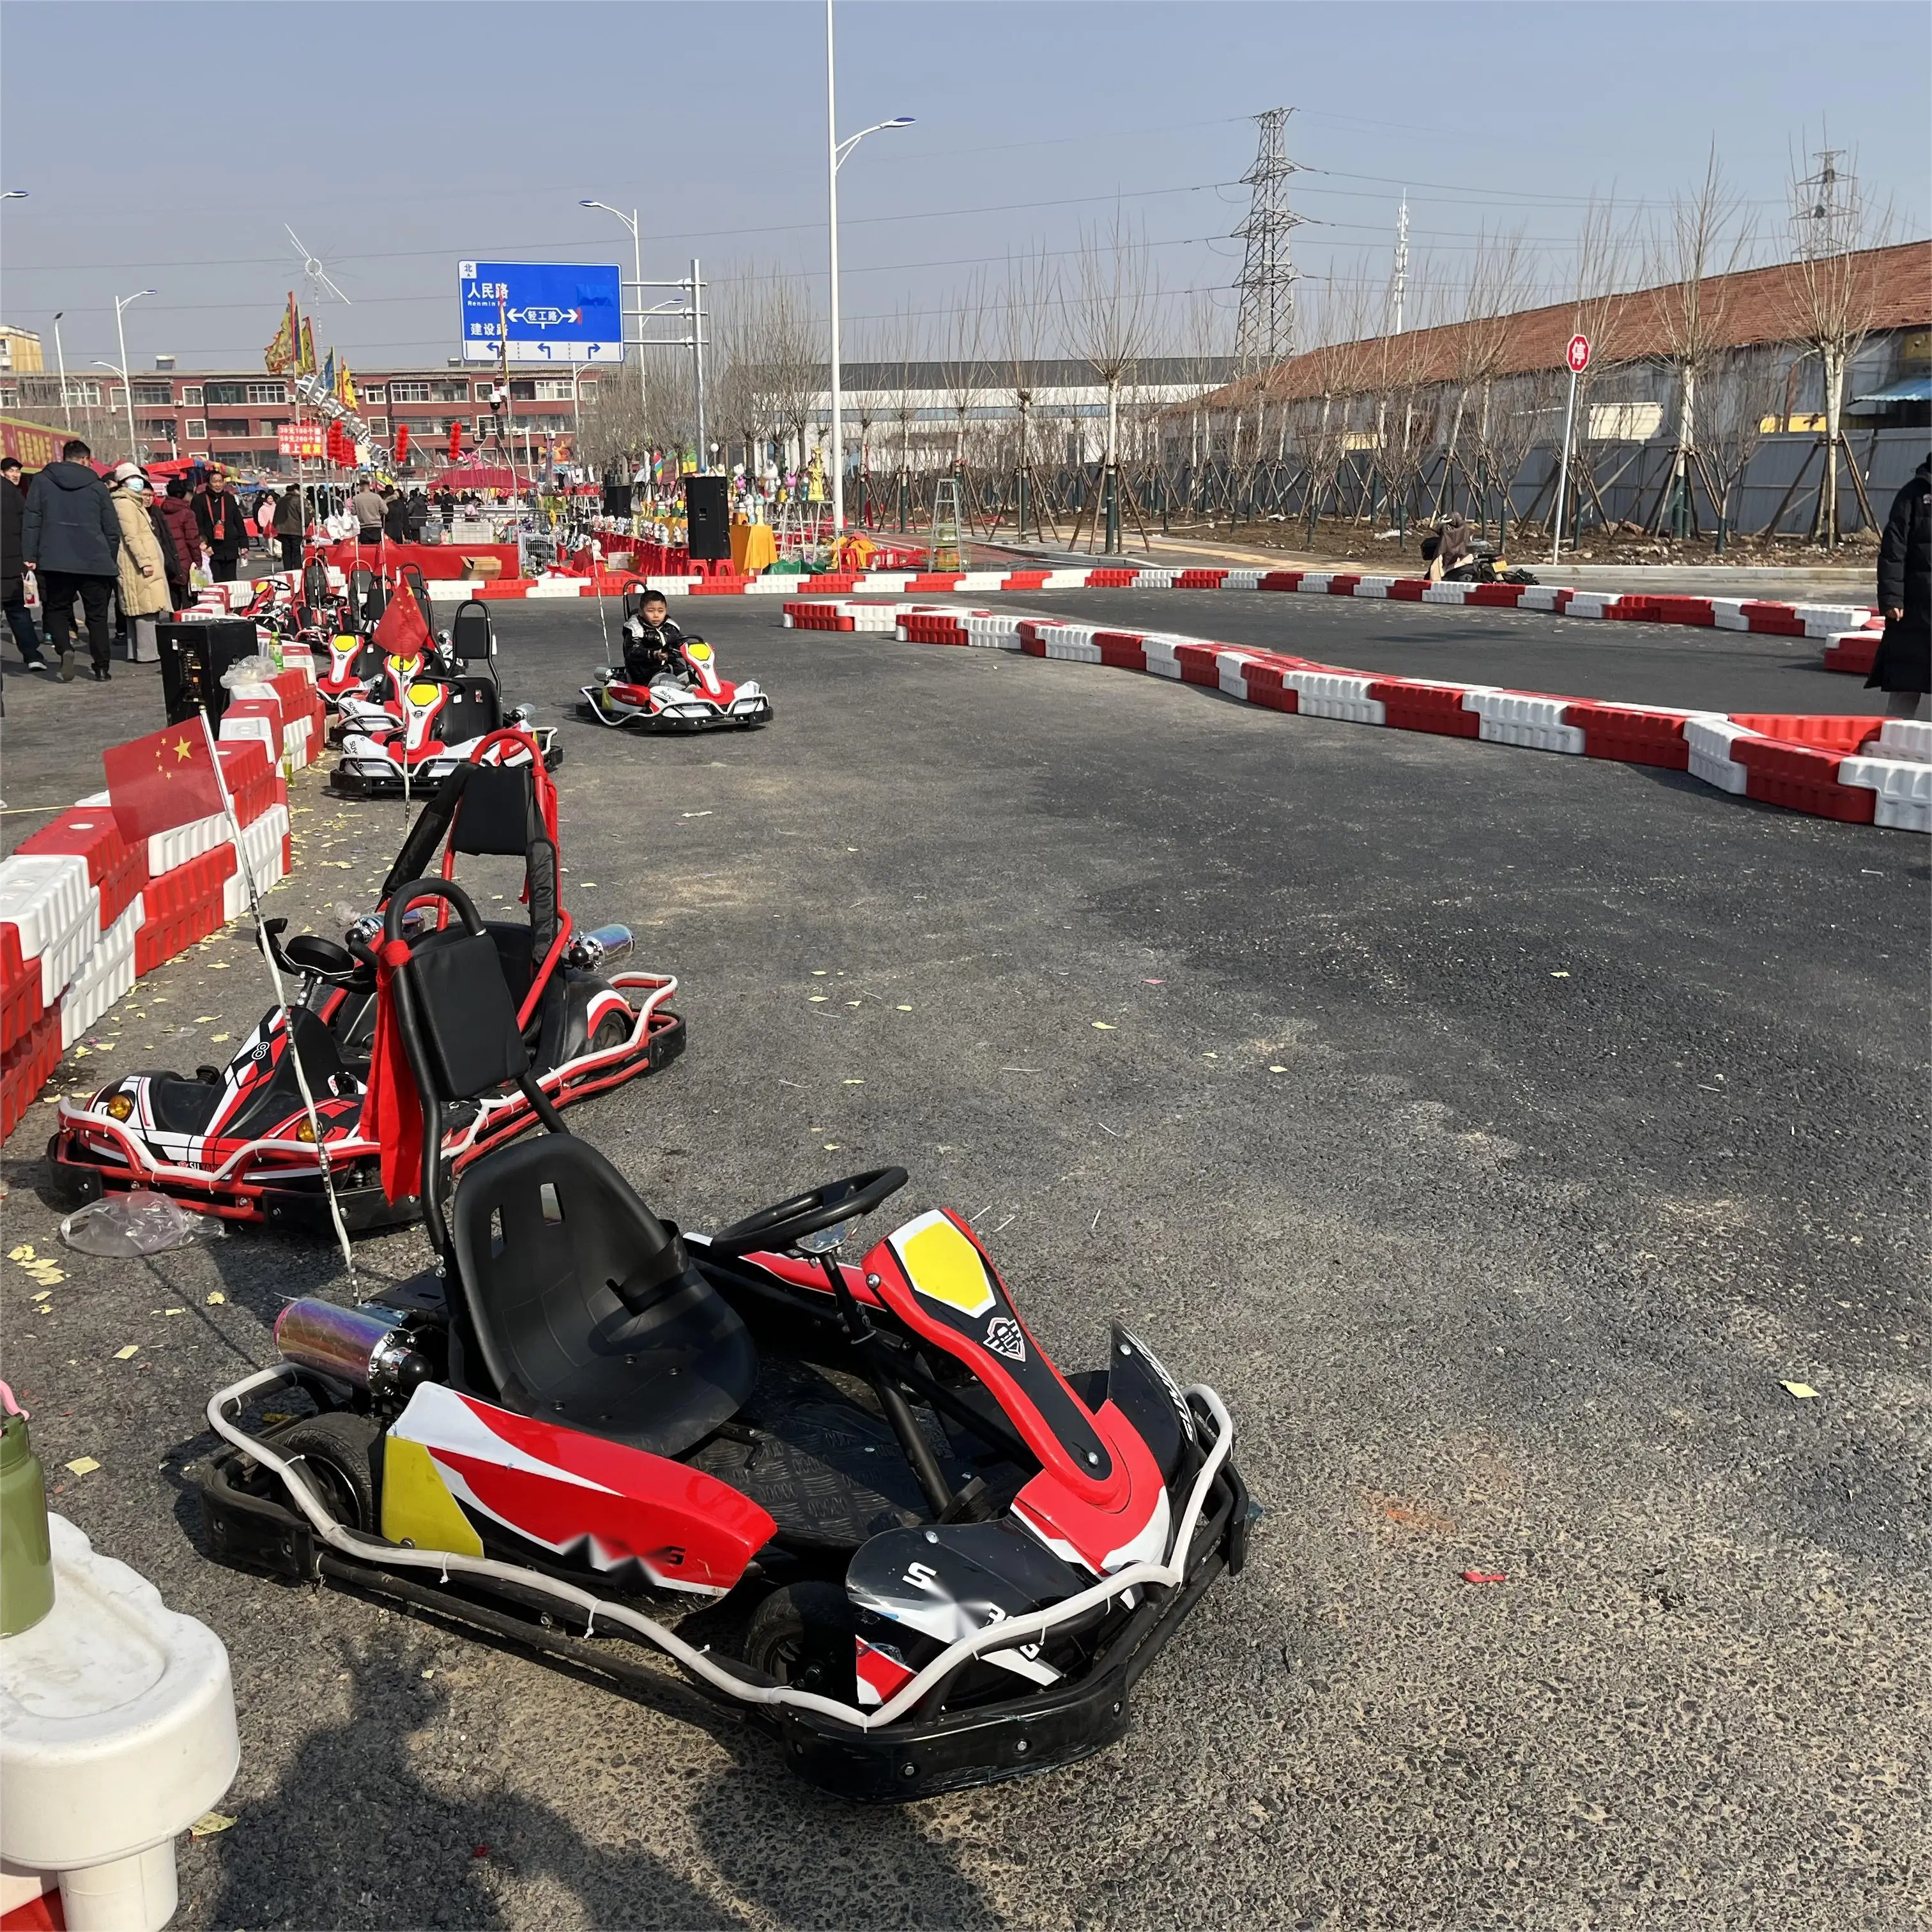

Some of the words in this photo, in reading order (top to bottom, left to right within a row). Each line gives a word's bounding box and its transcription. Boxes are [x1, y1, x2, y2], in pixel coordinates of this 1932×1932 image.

[464, 263, 473, 273] 北
[467, 282, 509, 300] 人民路
[527, 310, 557, 321] 轻工路
[1571, 341, 1586, 365] 停
[251, 1041, 270, 1060] 8
